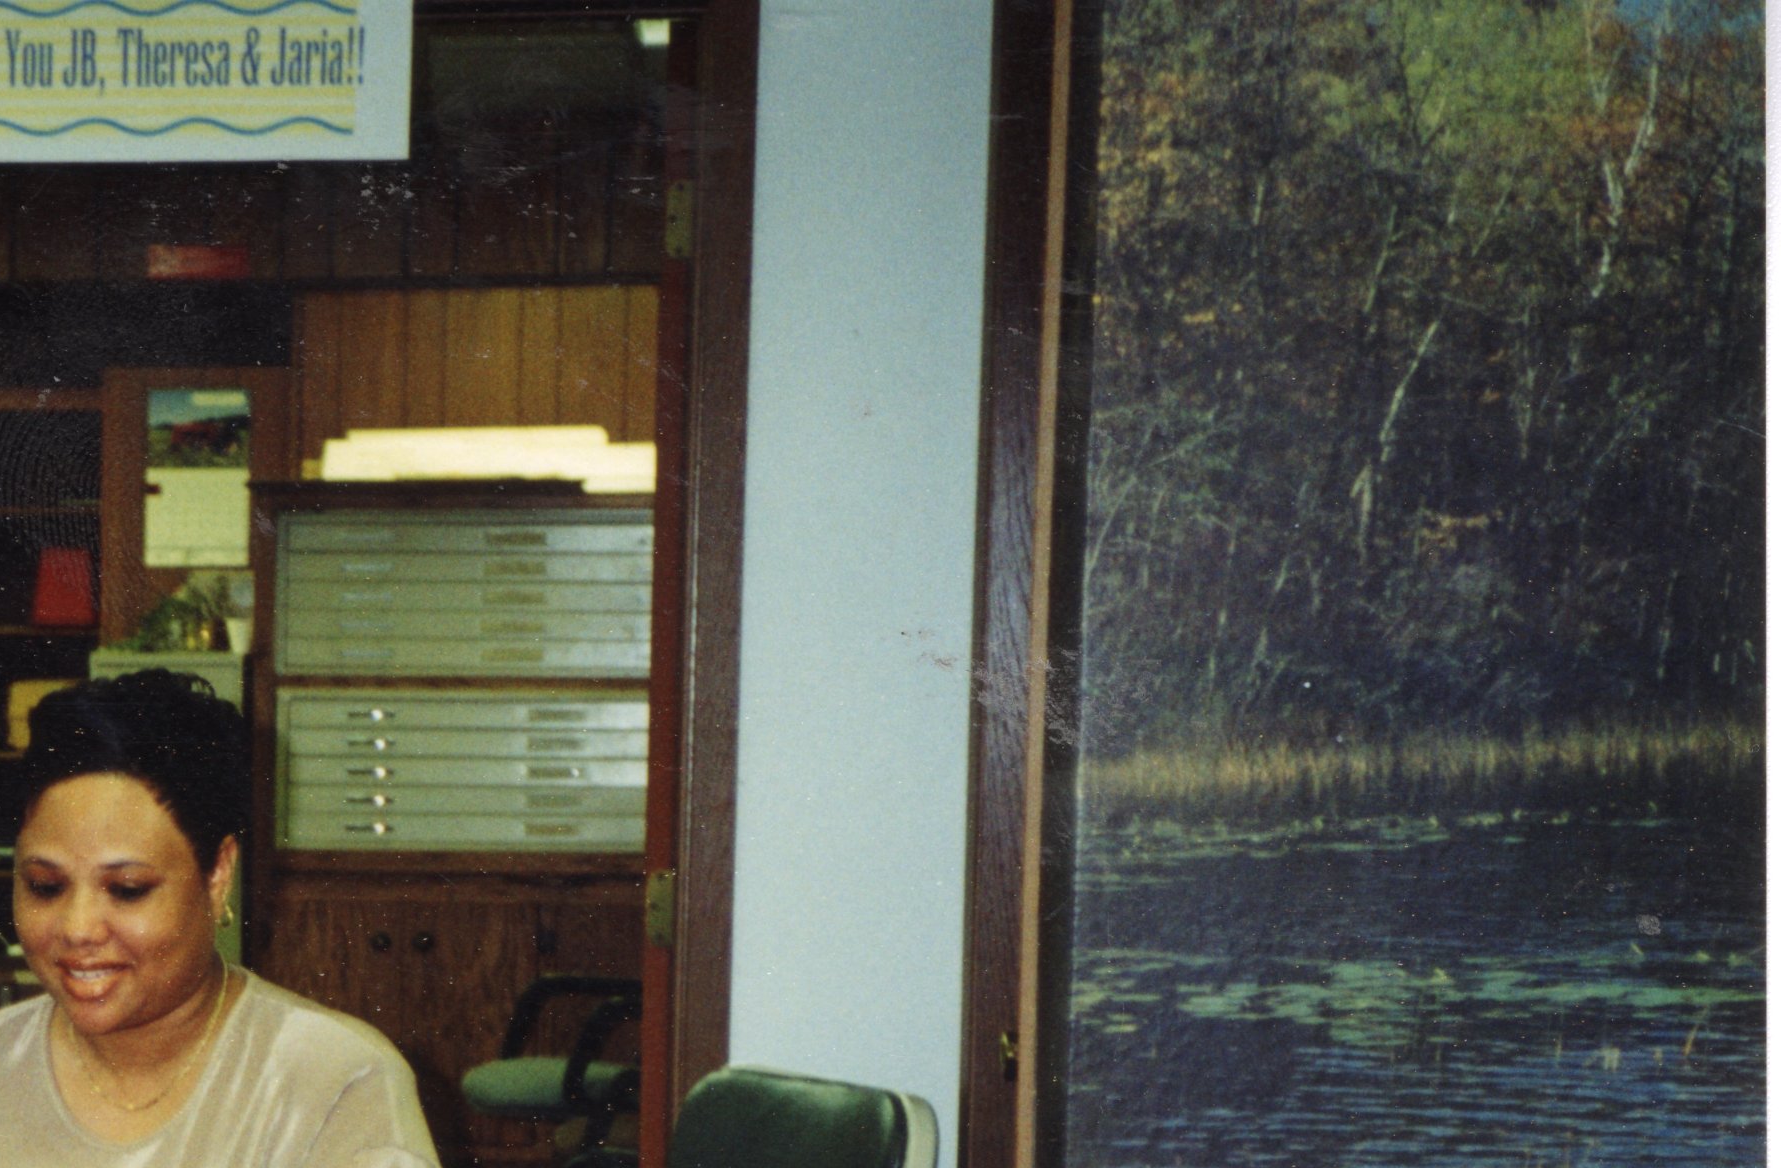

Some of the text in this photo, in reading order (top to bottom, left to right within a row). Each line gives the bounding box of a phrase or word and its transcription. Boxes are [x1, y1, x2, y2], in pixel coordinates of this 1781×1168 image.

[5, 28, 54, 87] You
[63, 27, 106, 96] JB,
[116, 27, 231, 87] Theresa
[241, 26, 261, 86] &
[270, 25, 365, 86] Jaria!!
